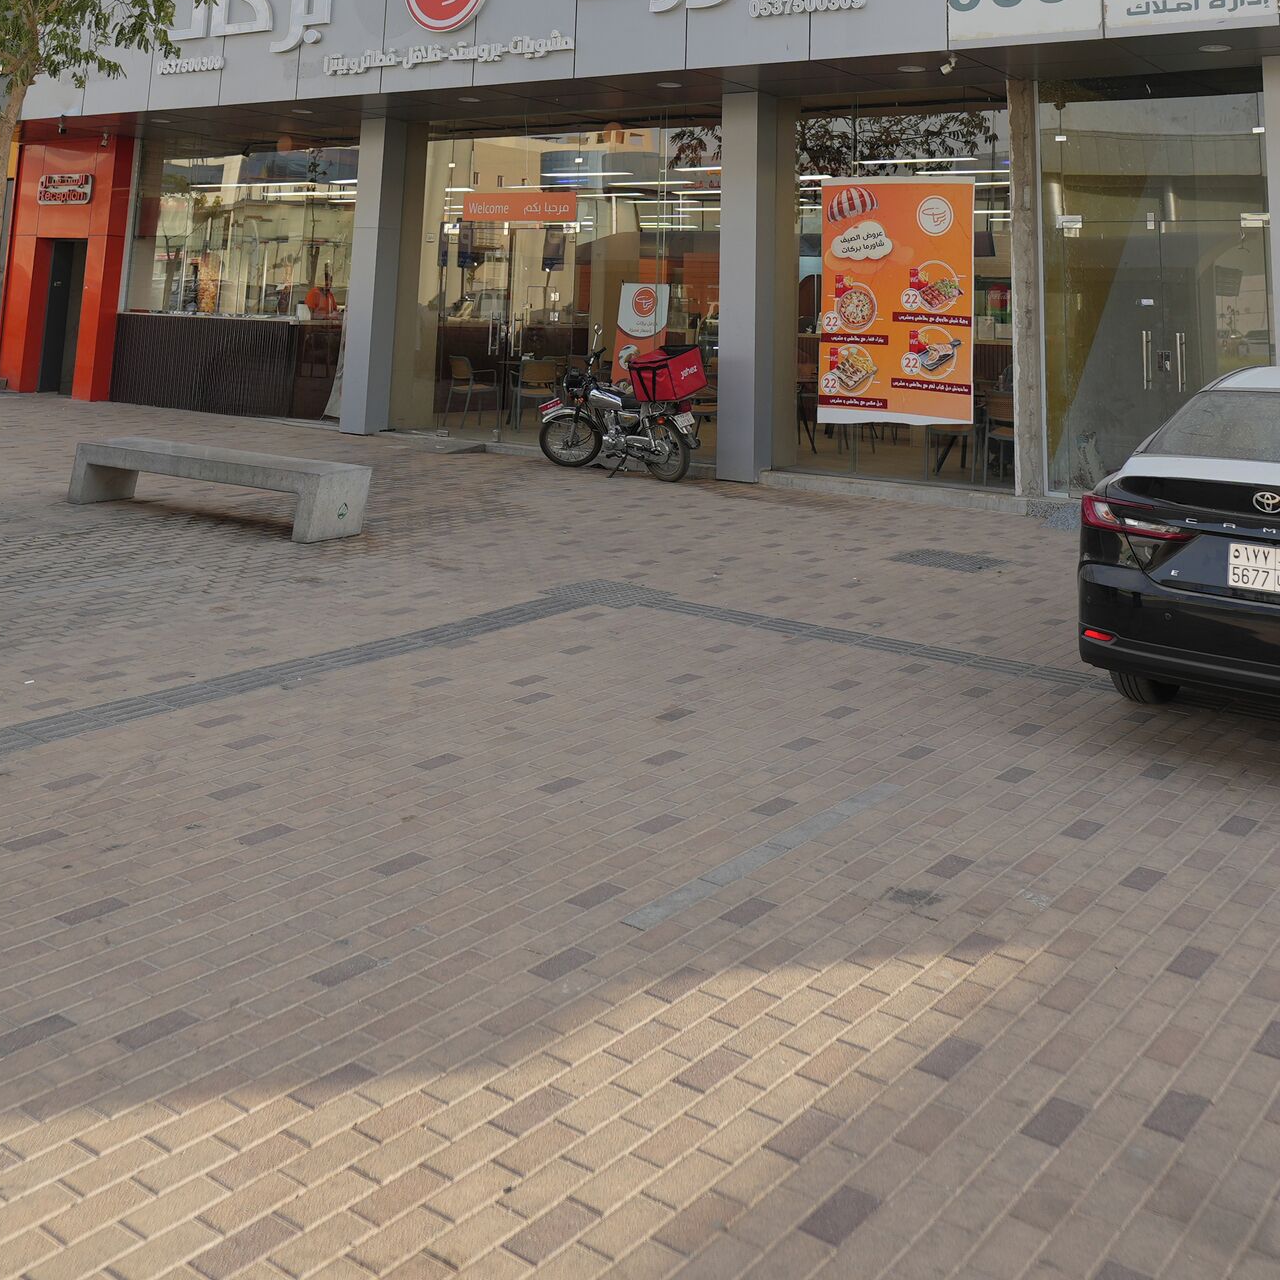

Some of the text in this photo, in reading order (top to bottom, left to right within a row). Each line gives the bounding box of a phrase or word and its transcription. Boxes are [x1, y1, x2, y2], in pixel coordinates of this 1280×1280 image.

[156, 55, 223, 76] 0537500309
[40, 189, 83, 202] Reception
[468, 202, 509, 215] Welcome
[523, 202, 570, 216] مرحبا بكم
[840, 231, 884, 244] عروض الصيف
[841, 240, 885, 254] شاورما بركات
[904, 293, 918, 304] 22
[825, 316, 838, 327] 22
[904, 358, 918, 369] 22
[823, 377, 837, 388] 22
[1231, 566, 1270, 587] 5677
